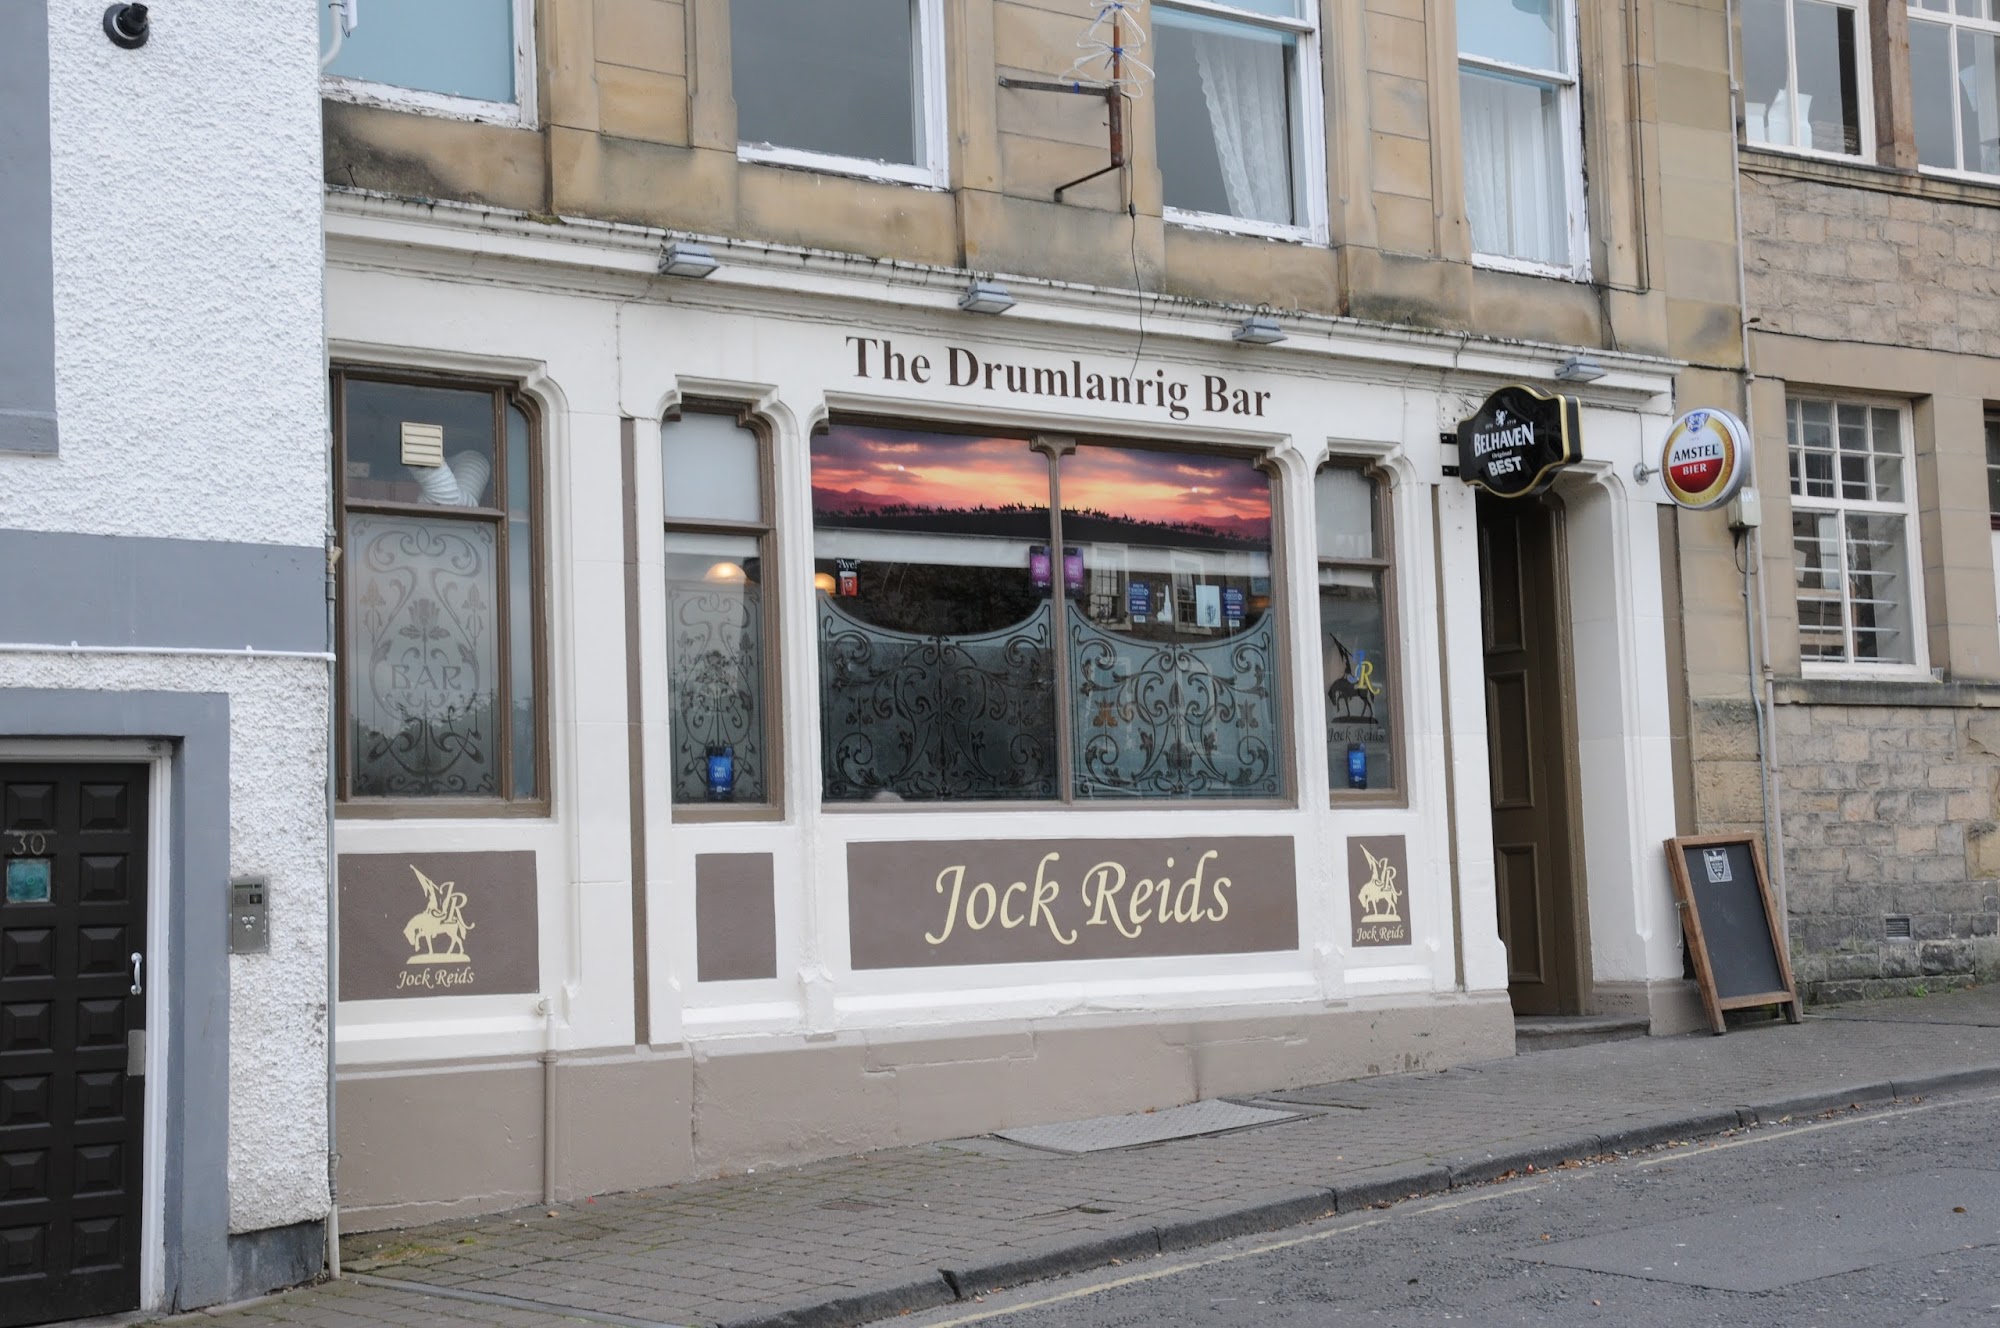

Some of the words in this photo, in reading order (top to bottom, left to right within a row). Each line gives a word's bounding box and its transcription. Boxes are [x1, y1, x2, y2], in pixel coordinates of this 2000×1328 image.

[845, 335, 932, 384] The
[945, 345, 1190, 421] Drumlanrig
[1201, 374, 1271, 418] Bar
[1474, 421, 1535, 458] BELHAVEN
[1673, 444, 1719, 462] AMSTEL
[1487, 455, 1522, 477] BEST
[1682, 463, 1708, 476] BIER
[391, 664, 462, 691] BAR
[1327, 727, 1352, 744] Jock
[11, 833, 47, 856] 30
[925, 851, 1078, 946] Jock
[1082, 849, 1232, 939] Reids
[1355, 925, 1380, 943] Jock
[1380, 924, 1405, 942] Reids
[396, 967, 434, 989] Jock
[434, 966, 475, 987] Reids
